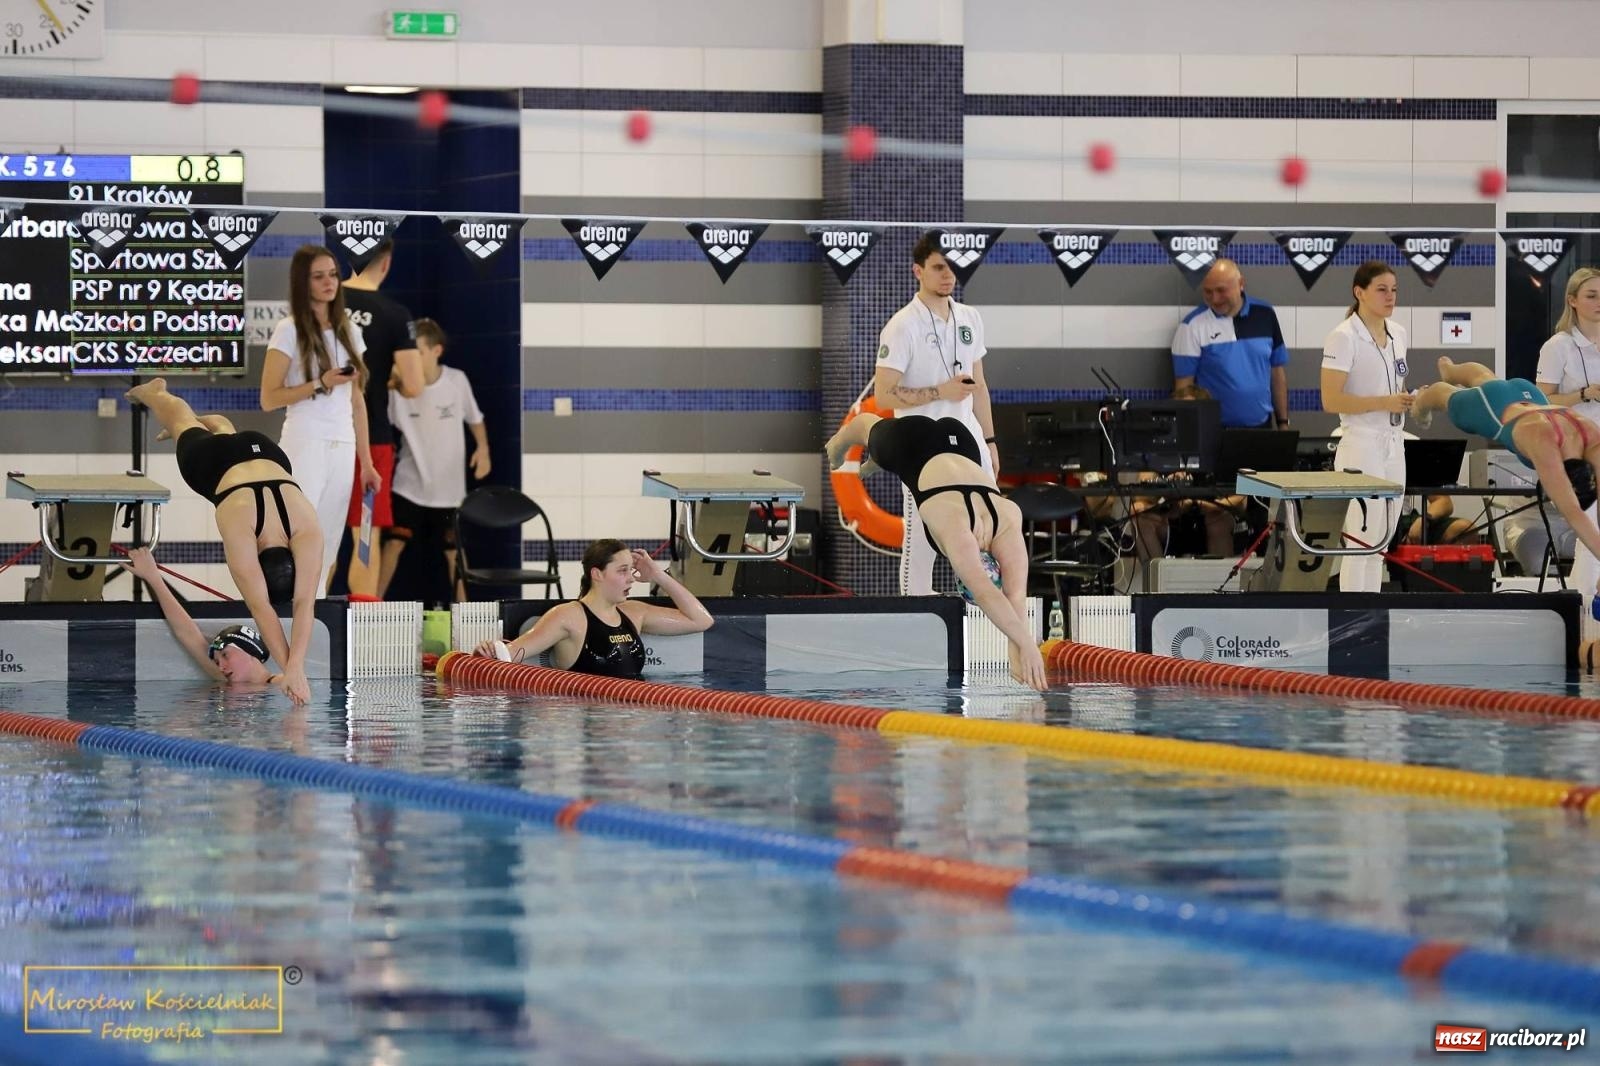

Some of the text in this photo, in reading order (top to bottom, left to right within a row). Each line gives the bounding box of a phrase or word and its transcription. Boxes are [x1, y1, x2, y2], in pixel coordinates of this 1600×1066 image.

[23, 155, 38, 177] 5
[61, 155, 76, 177] 6
[69, 184, 193, 205] 91 Kraków
[81, 211, 132, 229] arena
[208, 215, 258, 233] arena
[336, 218, 385, 236] arena
[459, 222, 507, 240] arena
[580, 225, 627, 243] arena
[703, 227, 750, 246] arena
[822, 230, 869, 248] arena
[940, 231, 986, 249] arena
[1053, 233, 1099, 251] arena
[1171, 235, 1218, 253] arena
[1288, 236, 1335, 253] arena
[1405, 236, 1452, 254] arena
[1518, 236, 1563, 254] arena
[71, 248, 186, 274] Sprtowa
[72, 279, 244, 306] PSP nr 9 Kędzie
[72, 310, 146, 332] Szkoła
[73, 341, 239, 363] CKS Szczecin 1
[67, 536, 98, 581] 3
[702, 533, 732, 577] 4
[1297, 532, 1331, 573] 5
[608, 633, 635, 644] arena
